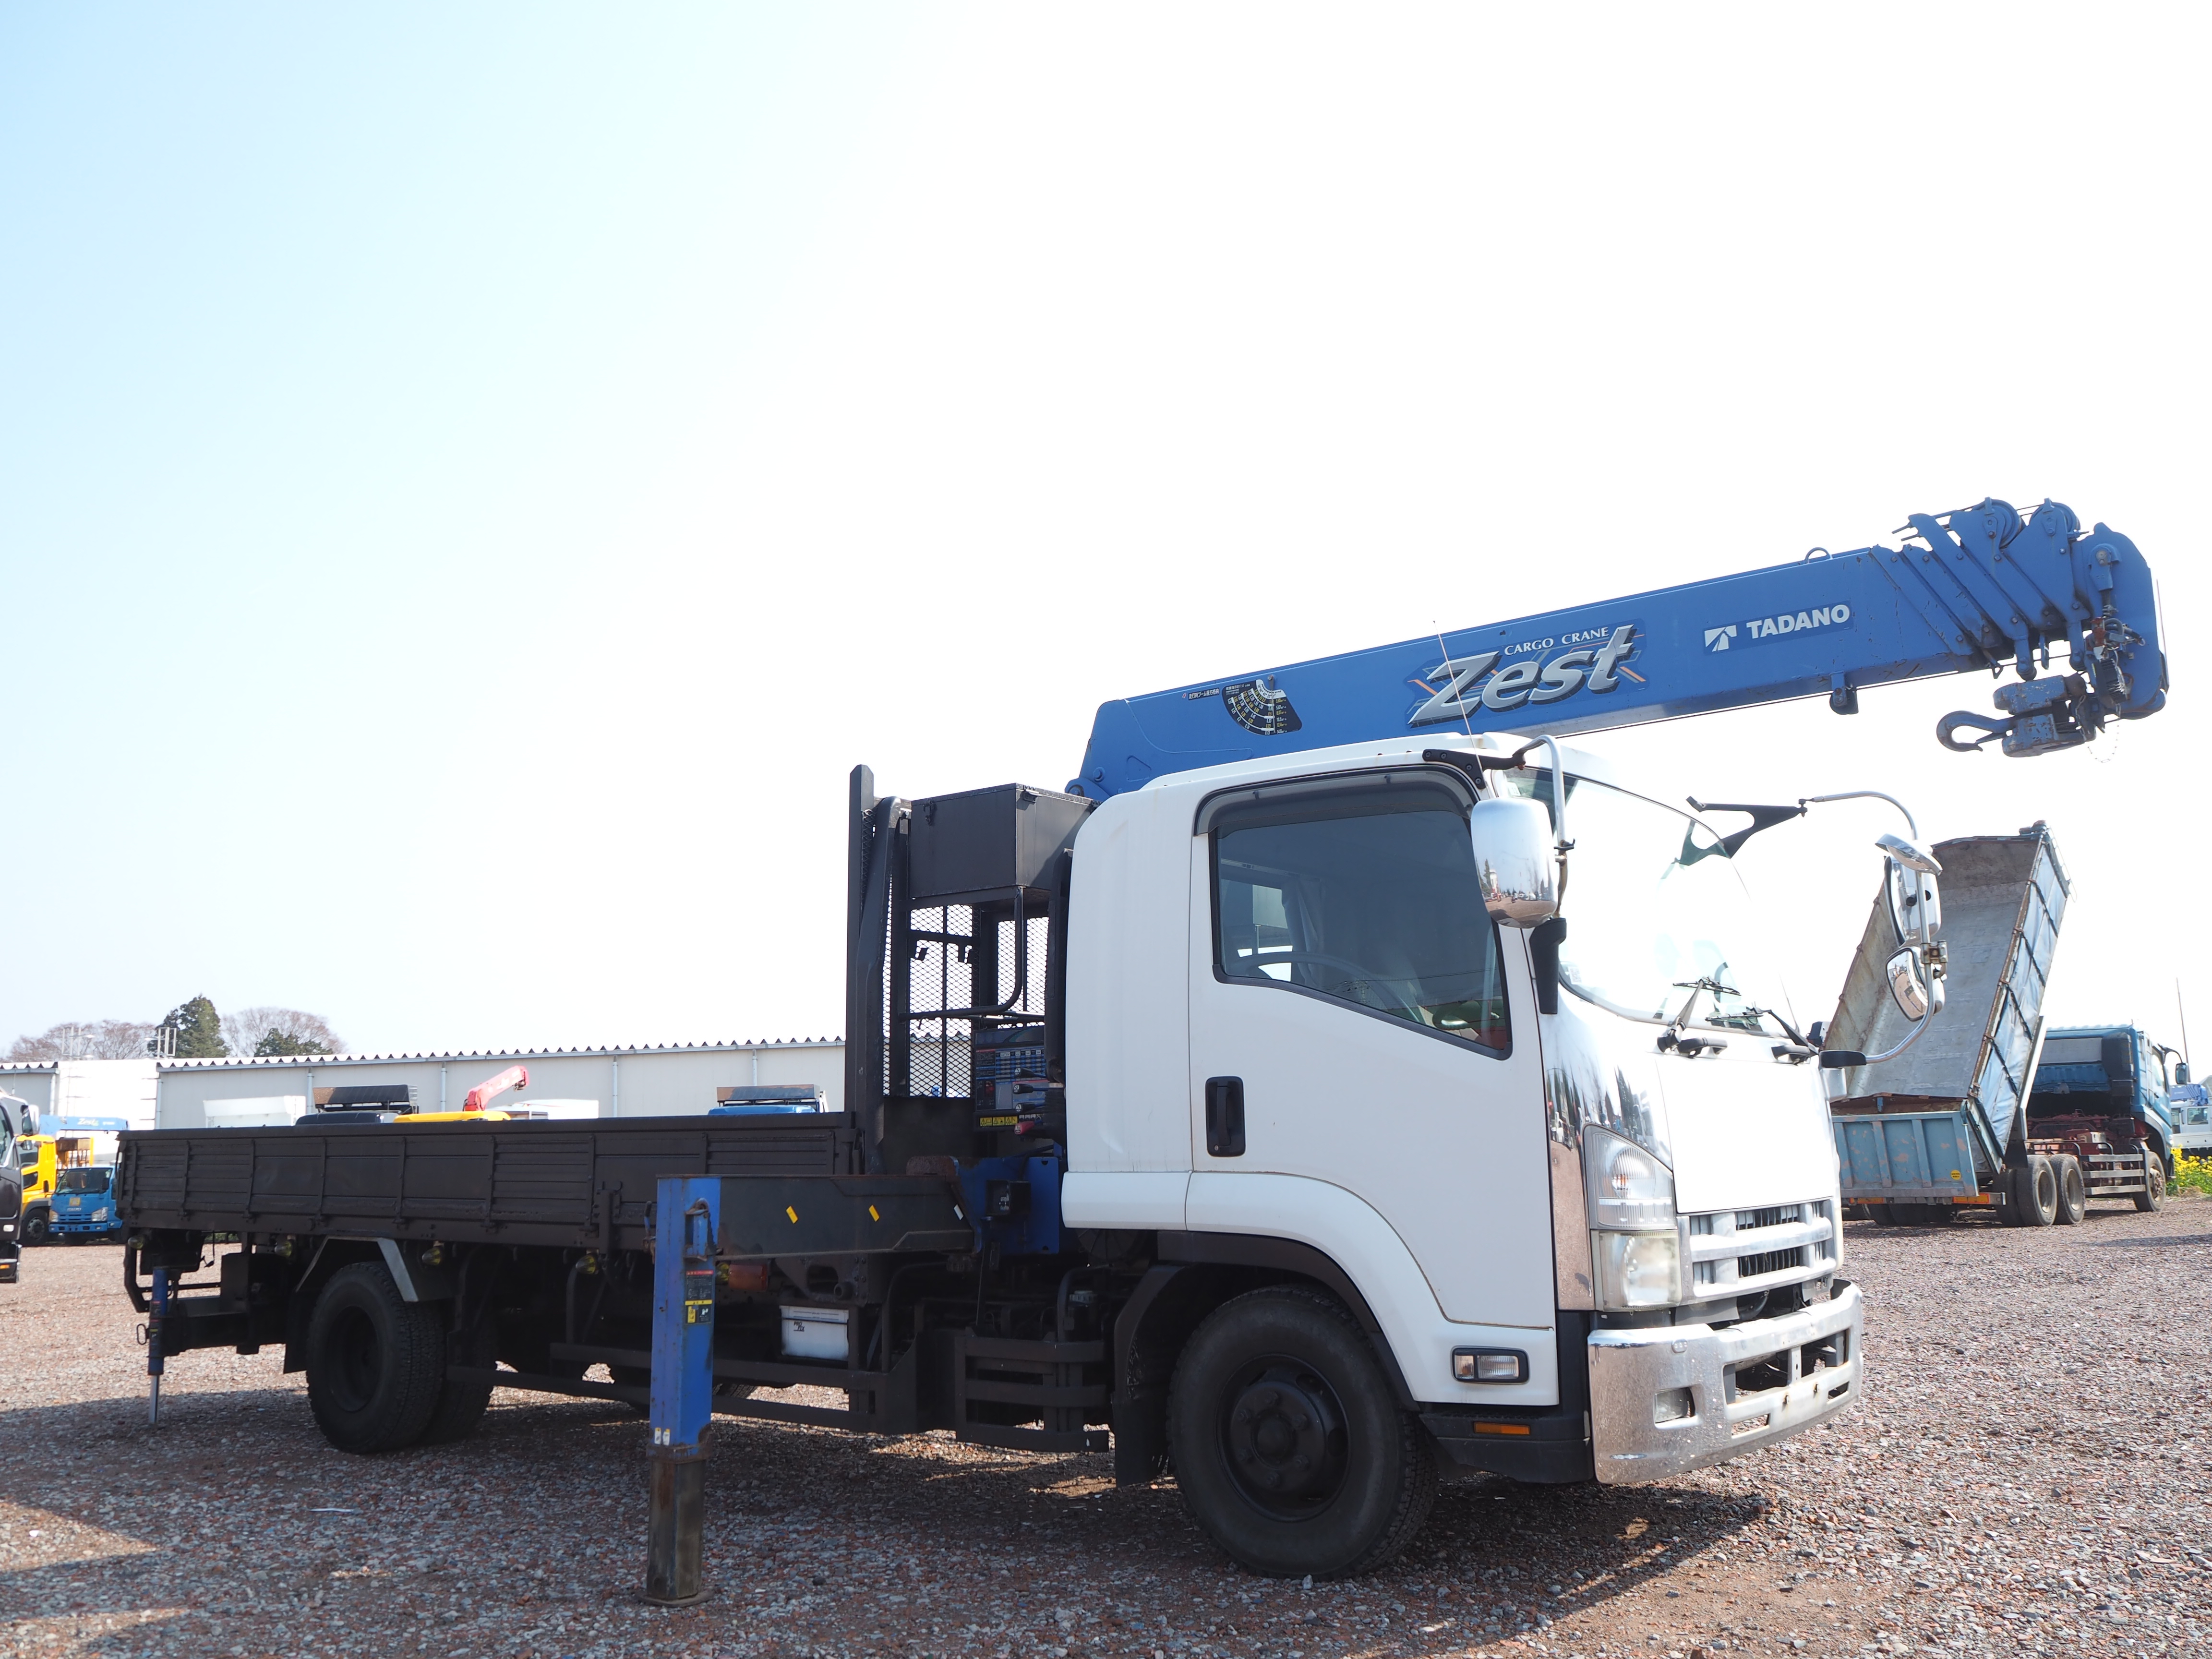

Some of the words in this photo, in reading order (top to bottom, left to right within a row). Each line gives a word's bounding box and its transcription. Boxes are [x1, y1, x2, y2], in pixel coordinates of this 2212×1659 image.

[1746, 604, 1850, 639] TADANO
[1504, 637, 1554, 656] CARGO
[1561, 627, 1610, 645] CRANE
[1407, 624, 1636, 727] Zest
